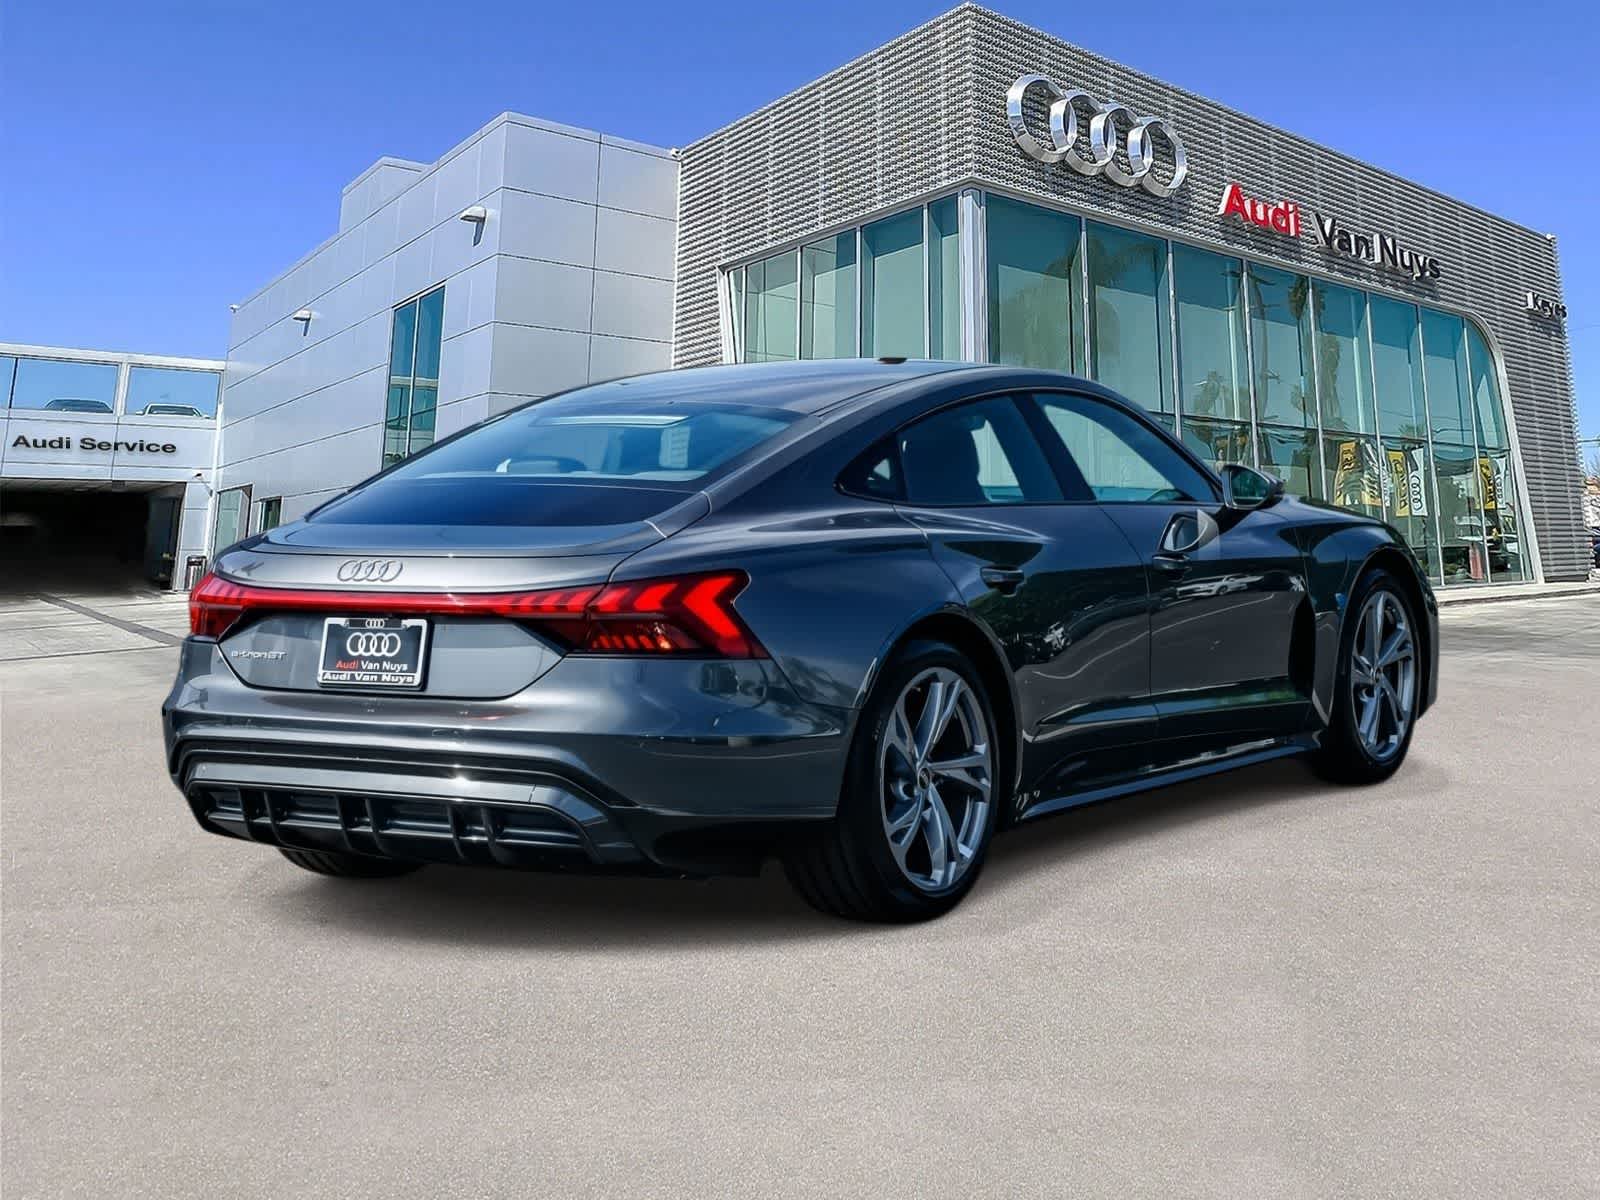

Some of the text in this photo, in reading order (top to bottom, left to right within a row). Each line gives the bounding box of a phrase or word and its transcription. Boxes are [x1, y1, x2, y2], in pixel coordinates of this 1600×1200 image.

[1218, 183, 1441, 281] Audi Van Nuys
[12, 435, 177, 454] Audi Service
[335, 660, 408, 672] Audi Van Nuys
[323, 671, 415, 684] Audi Van Nuys
